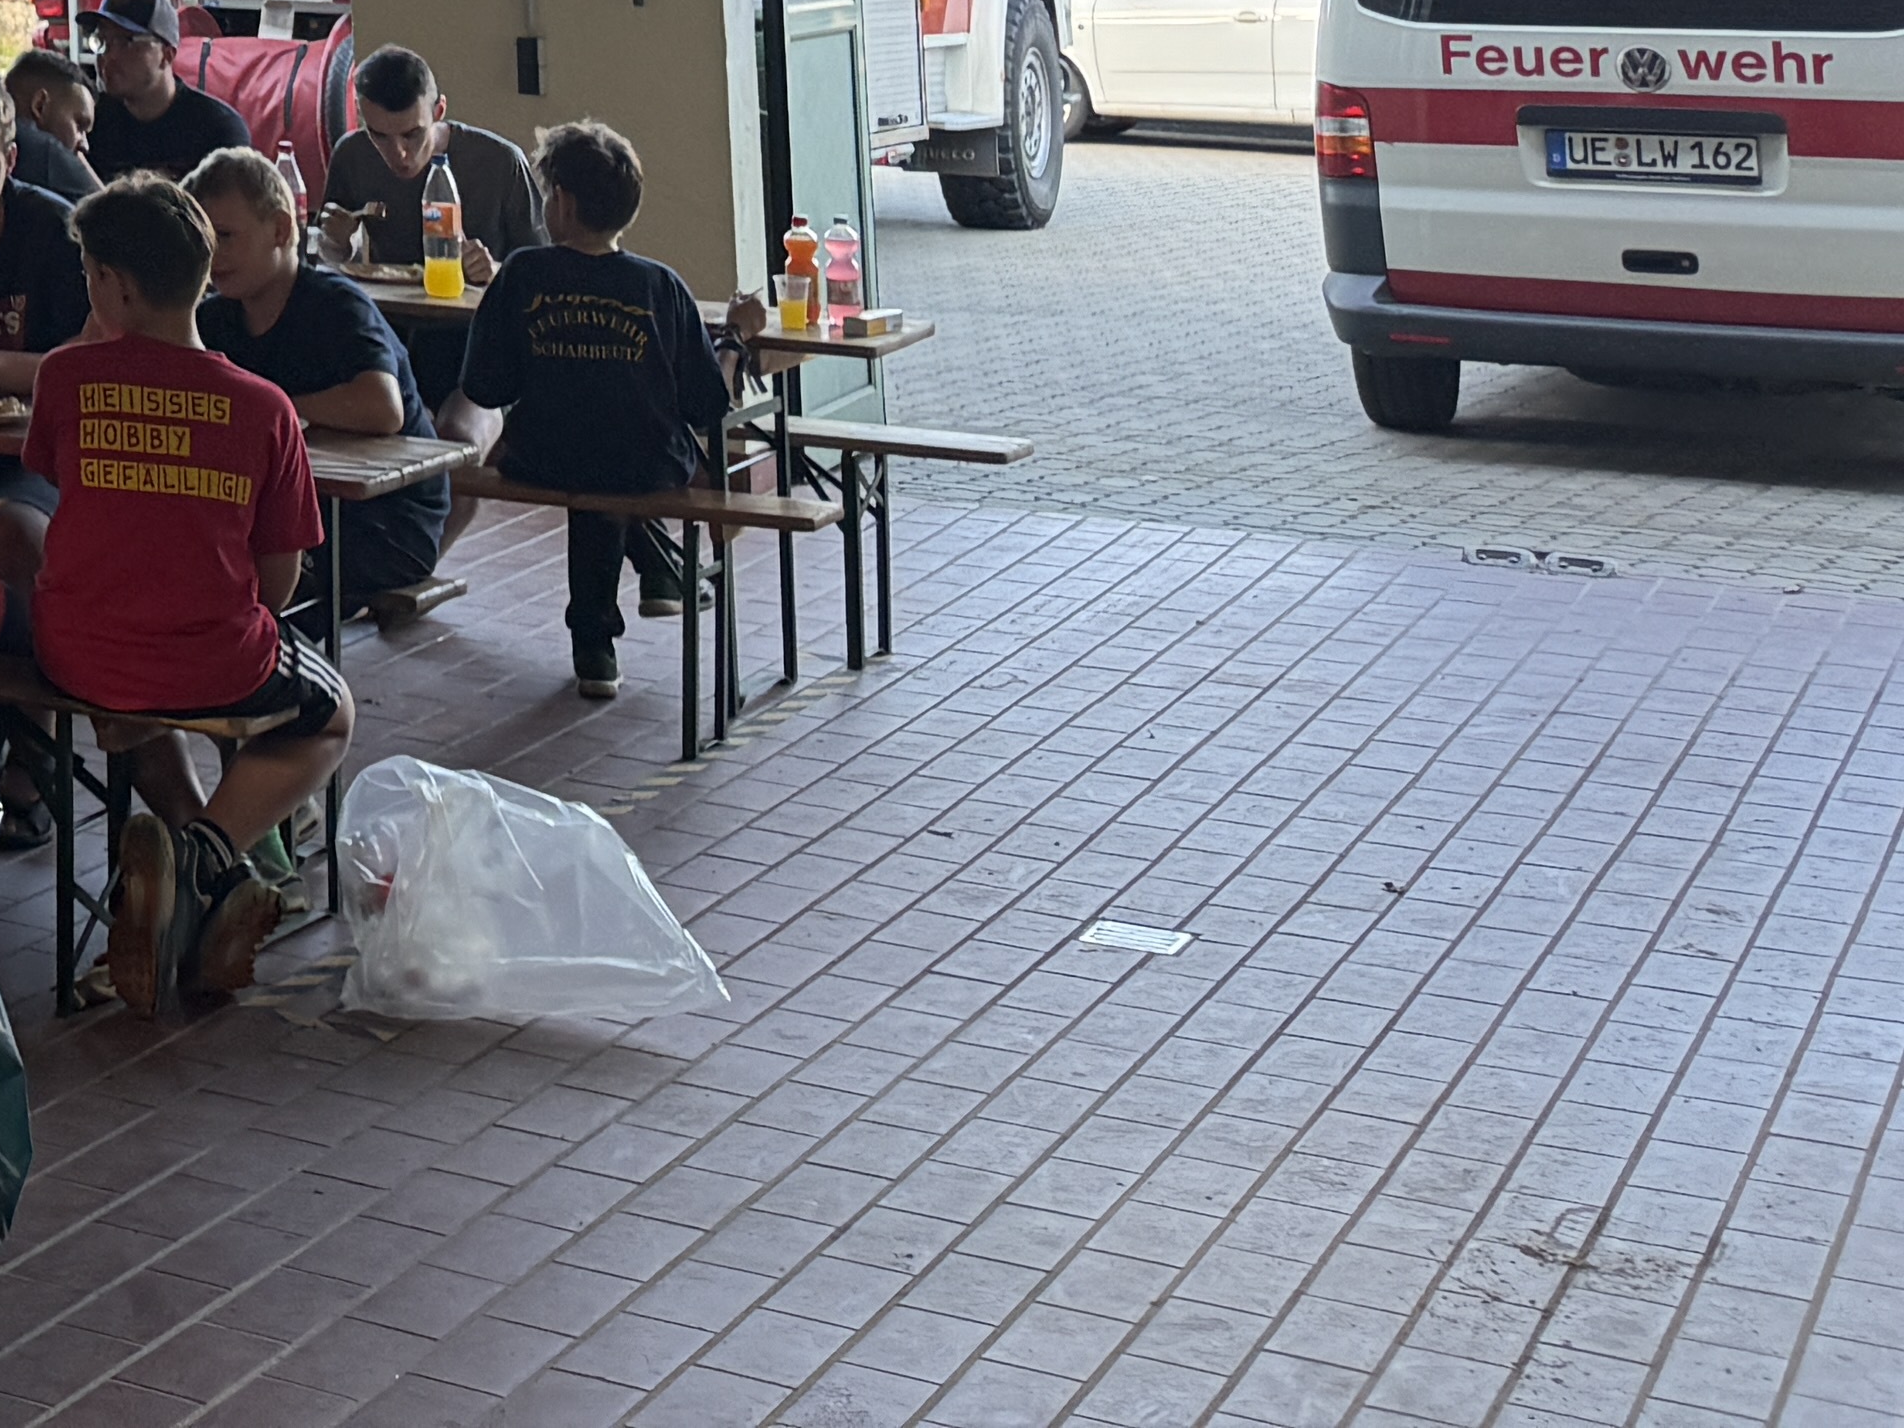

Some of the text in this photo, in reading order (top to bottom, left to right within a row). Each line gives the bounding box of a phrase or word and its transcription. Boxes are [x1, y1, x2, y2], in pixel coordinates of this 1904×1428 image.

[1439, 34, 1834, 85] Feuer wehr
[1567, 135, 1612, 166] UE
[1636, 137, 1679, 169] LW
[1689, 140, 1755, 172] 162
[528, 309, 648, 345] FEUERWEHR
[81, 384, 230, 424] HEISSES
[81, 419, 190, 456] HOBBY
